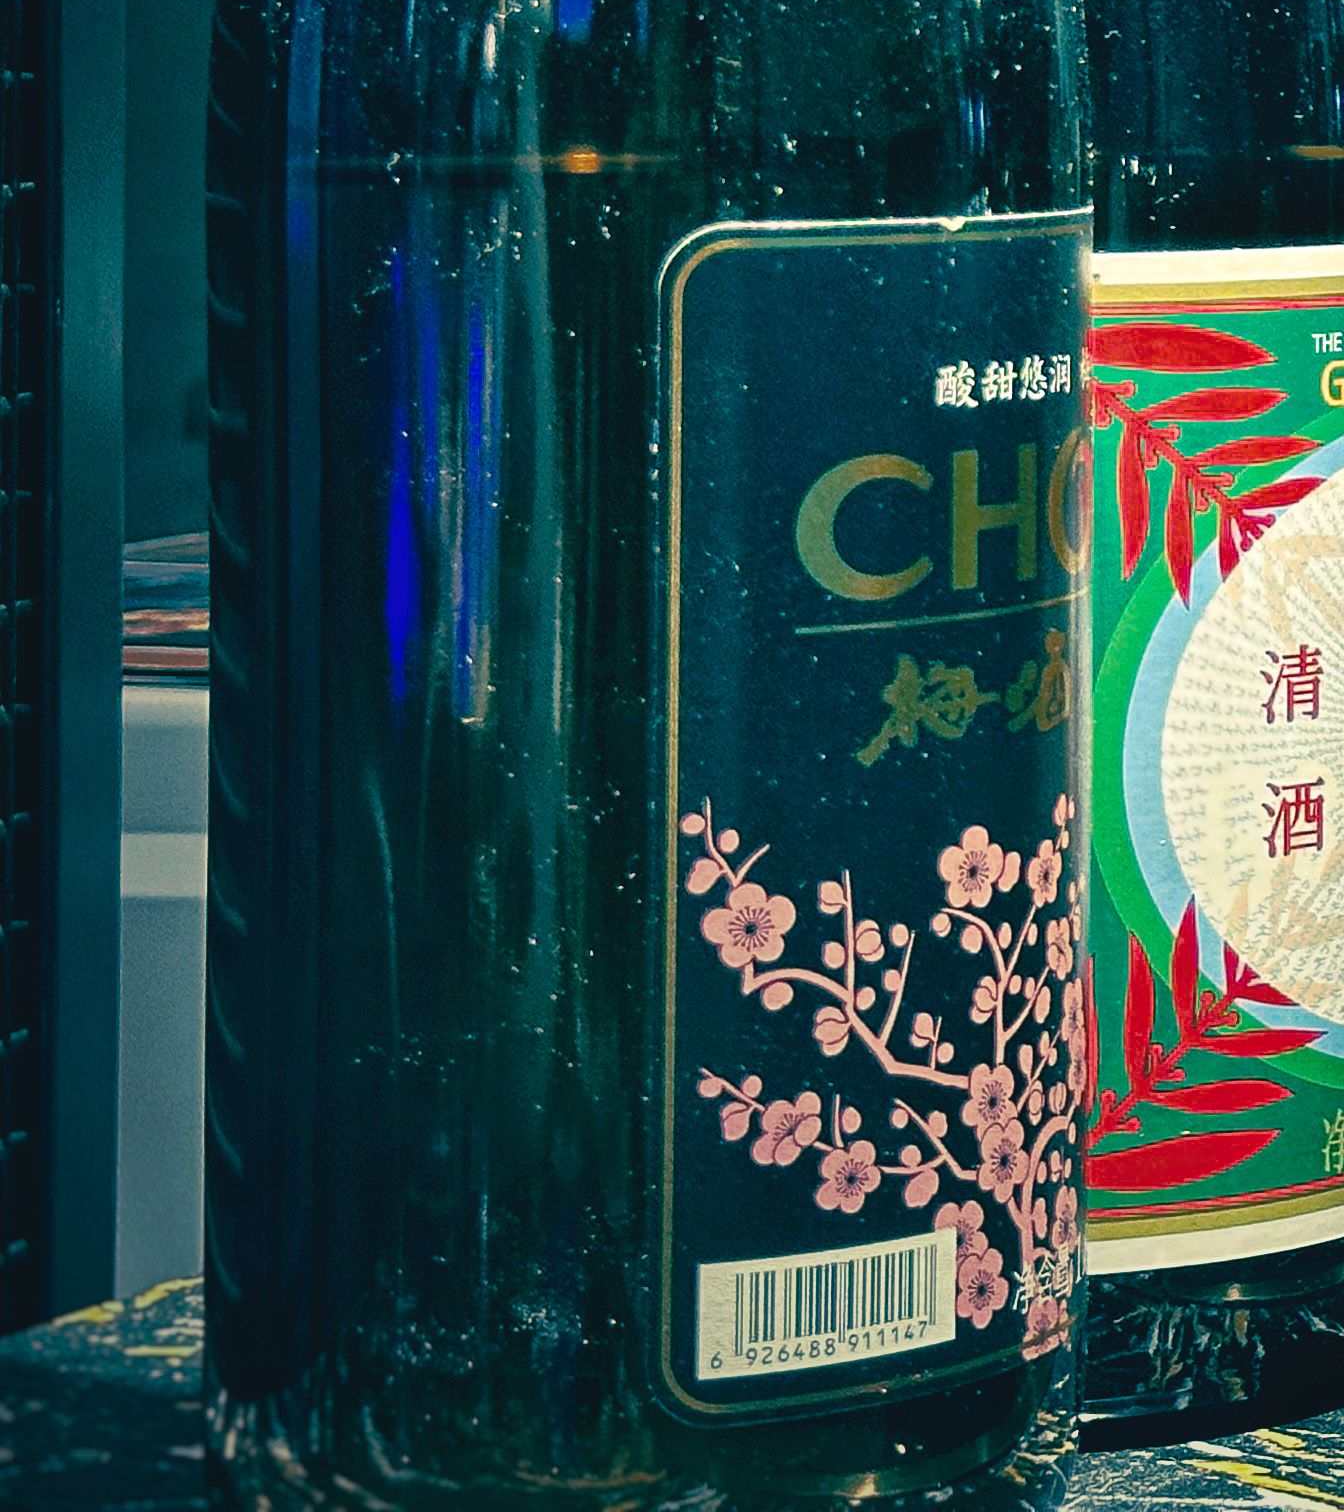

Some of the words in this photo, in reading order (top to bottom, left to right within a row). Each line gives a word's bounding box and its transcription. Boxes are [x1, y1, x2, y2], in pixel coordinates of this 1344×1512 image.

[1311, 332, 1342, 354] THE
[1260, 643, 1326, 859] 清酒
[745, 1337, 837, 1366] 926488
[847, 1320, 928, 1353] 911147
